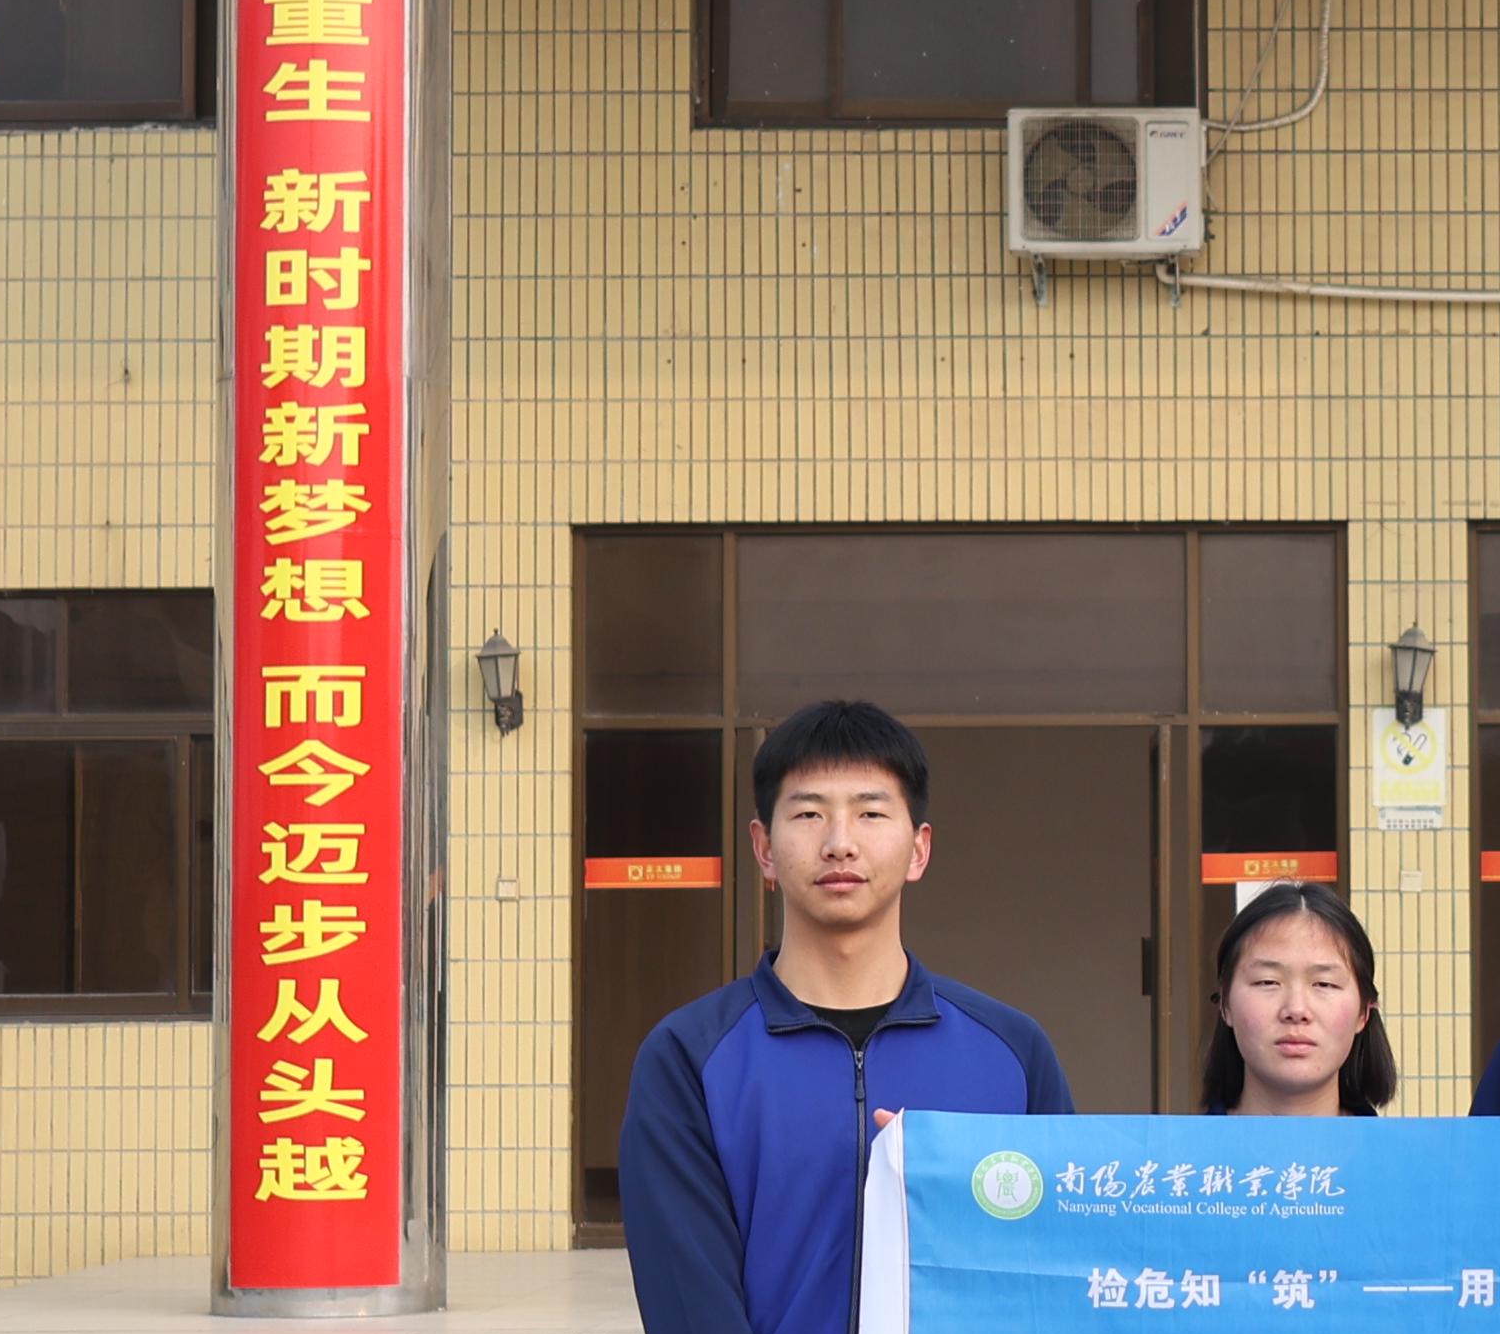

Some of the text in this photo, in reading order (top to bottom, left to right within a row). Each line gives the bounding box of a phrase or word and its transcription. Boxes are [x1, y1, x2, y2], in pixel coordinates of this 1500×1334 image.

[259, 166, 372, 623] 新时期新梦想
[255, 664, 371, 1202] 而今迈步从头越
[1057, 1199, 1345, 1219] Nanyang Vocational College of Agriculture
